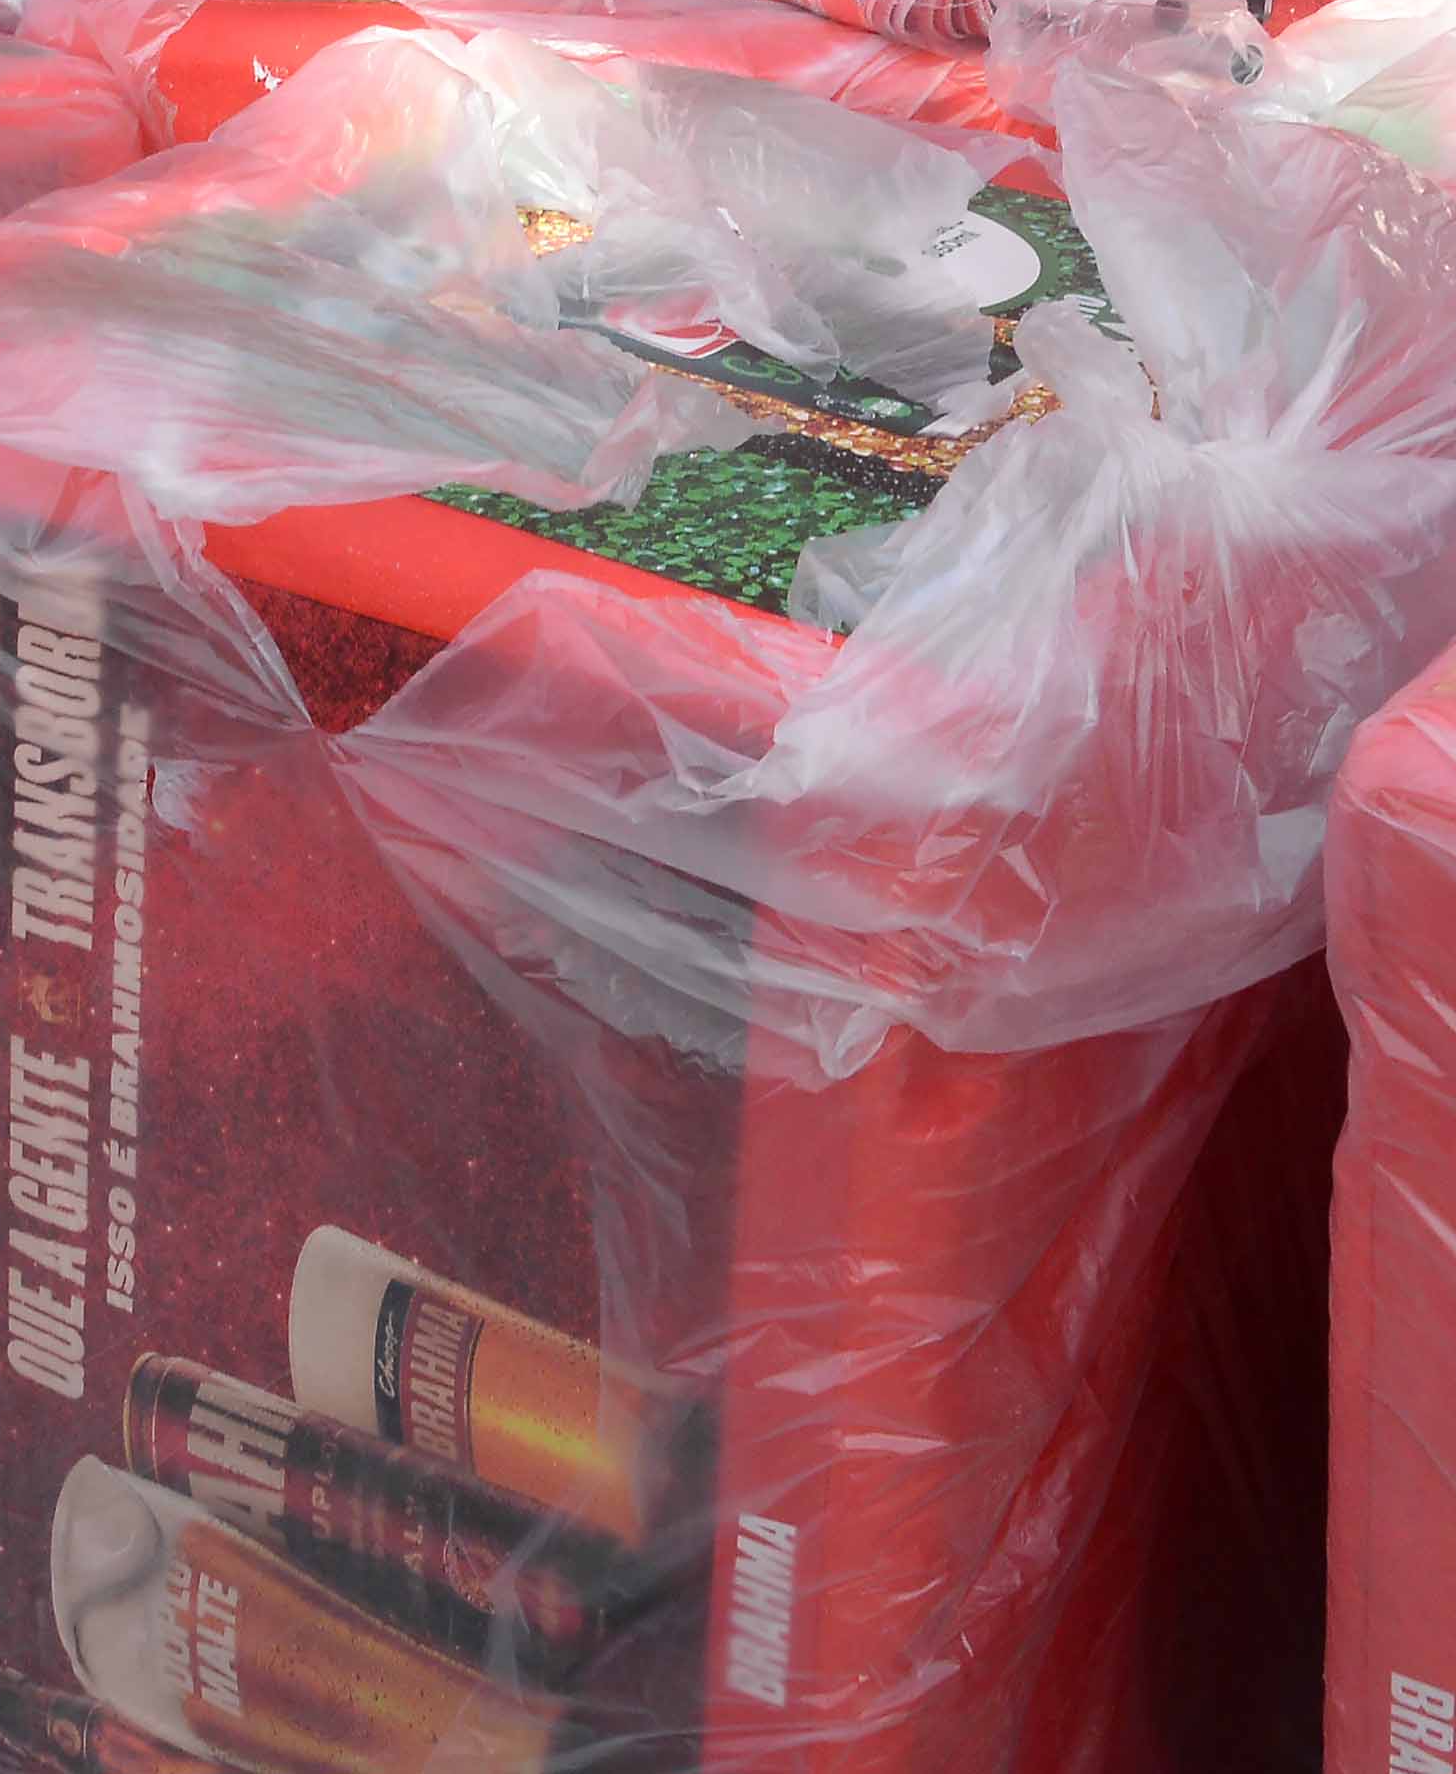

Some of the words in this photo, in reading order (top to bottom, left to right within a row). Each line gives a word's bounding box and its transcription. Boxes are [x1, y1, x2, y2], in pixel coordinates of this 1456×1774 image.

[8, 1034, 90, 1233] GENTE
[102, 1137, 137, 1179] É
[8, 1228, 87, 1287] A
[106, 1185, 138, 1315] ISSO
[6, 1267, 86, 1400] QUE
[409, 1302, 470, 1462] BRAHMA
[196, 1570, 241, 1716] MALTE
[723, 1512, 799, 1707] BRAHMA
[1389, 1671, 1456, 1774] BRA
